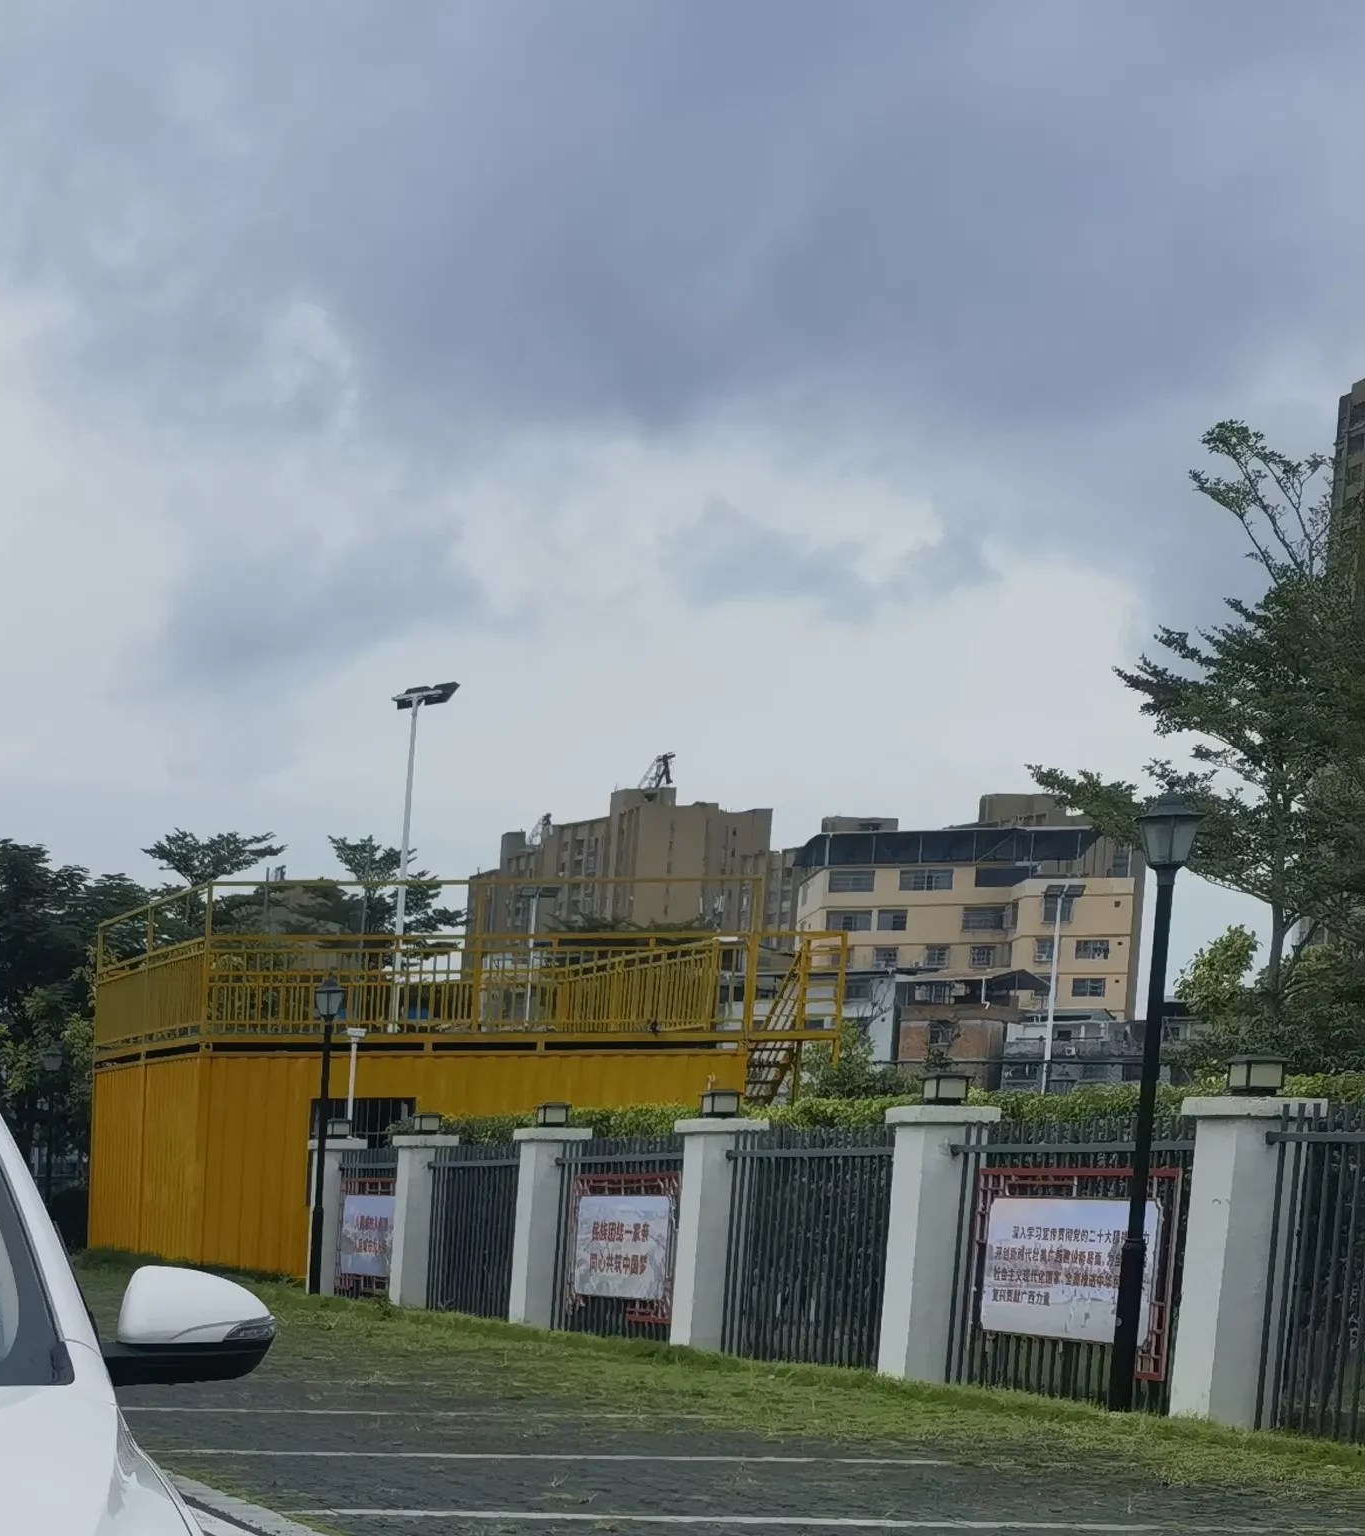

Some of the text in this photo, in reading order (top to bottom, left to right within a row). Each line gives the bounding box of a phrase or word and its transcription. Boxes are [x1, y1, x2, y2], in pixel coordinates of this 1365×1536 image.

[590, 1220, 650, 1242] 民族团结一家亲
[589, 1251, 649, 1276] 同心共筑中国梦
